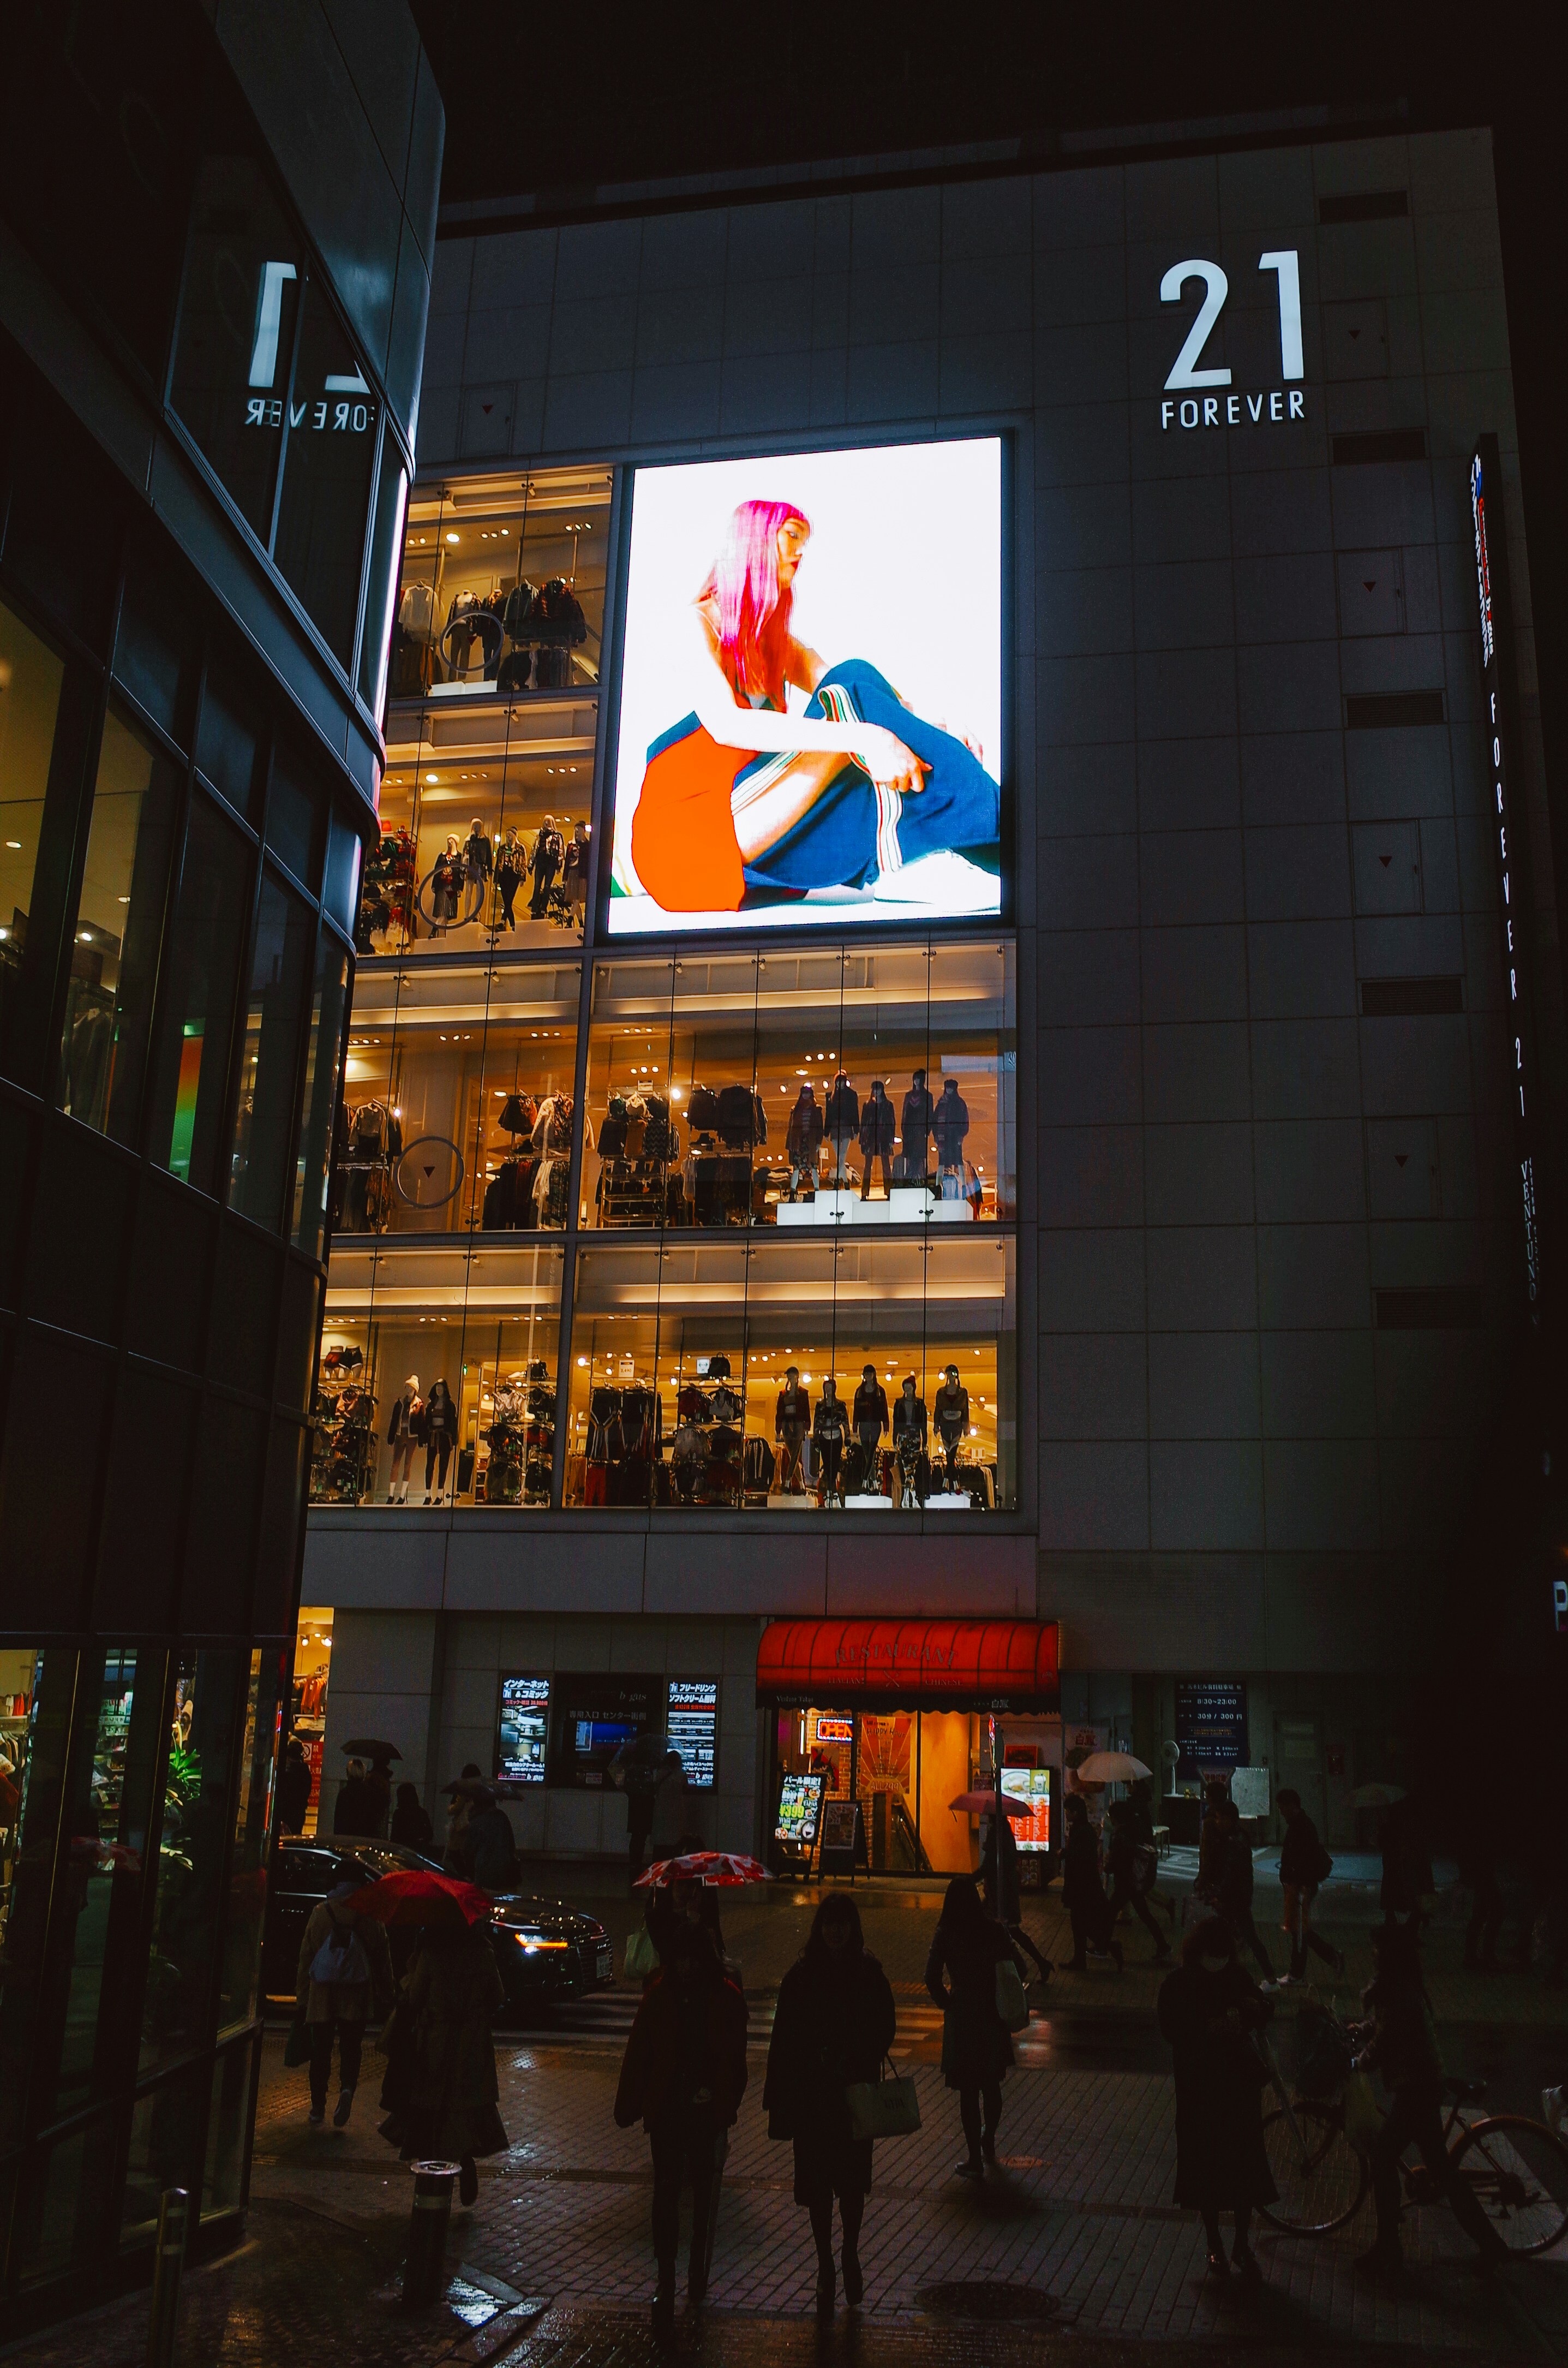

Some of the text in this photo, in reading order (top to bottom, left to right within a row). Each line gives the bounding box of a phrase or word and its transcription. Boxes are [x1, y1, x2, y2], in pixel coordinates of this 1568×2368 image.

[1160, 250, 1304, 390] 21
[1162, 390, 1304, 430] FOREVER
[1491, 691, 1525, 1117] FOREVER 21
[1521, 1161, 1537, 1301] VENTUNO
[835, 1643, 958, 1666] RESTAURANT
[504, 1679, 549, 1689] インターネット
[679, 1684, 716, 1693] フリードリンク
[925, 1678, 963, 1686] CHINESE
[820, 1722, 853, 1738] OPEN
[779, 1804, 805, 1818] ¥399
